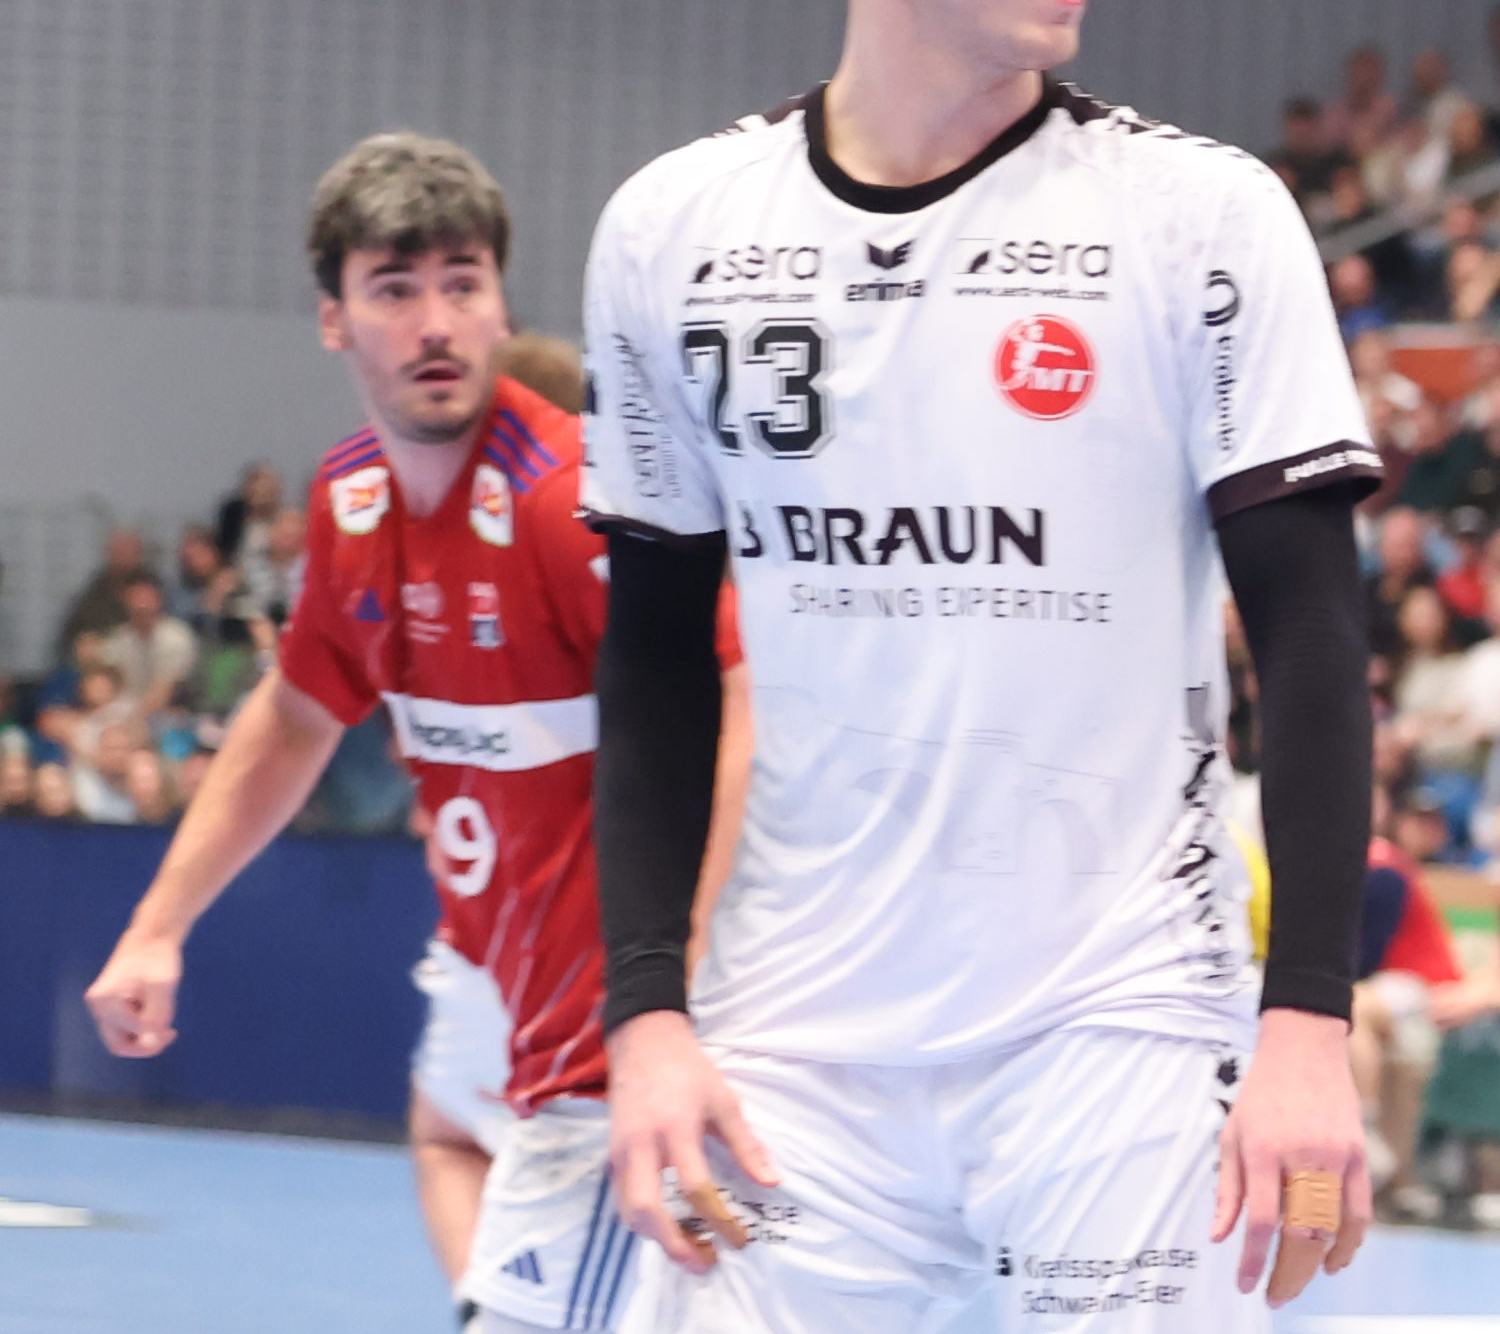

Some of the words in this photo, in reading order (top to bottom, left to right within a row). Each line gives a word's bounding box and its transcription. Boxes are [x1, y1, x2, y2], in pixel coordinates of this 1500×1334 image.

[718, 244, 822, 281] sera
[996, 239, 1112, 279] sera
[774, 505, 1048, 567] BRAUN
[936, 586, 1113, 623] EXPERTISE
[436, 794, 498, 898] 9
